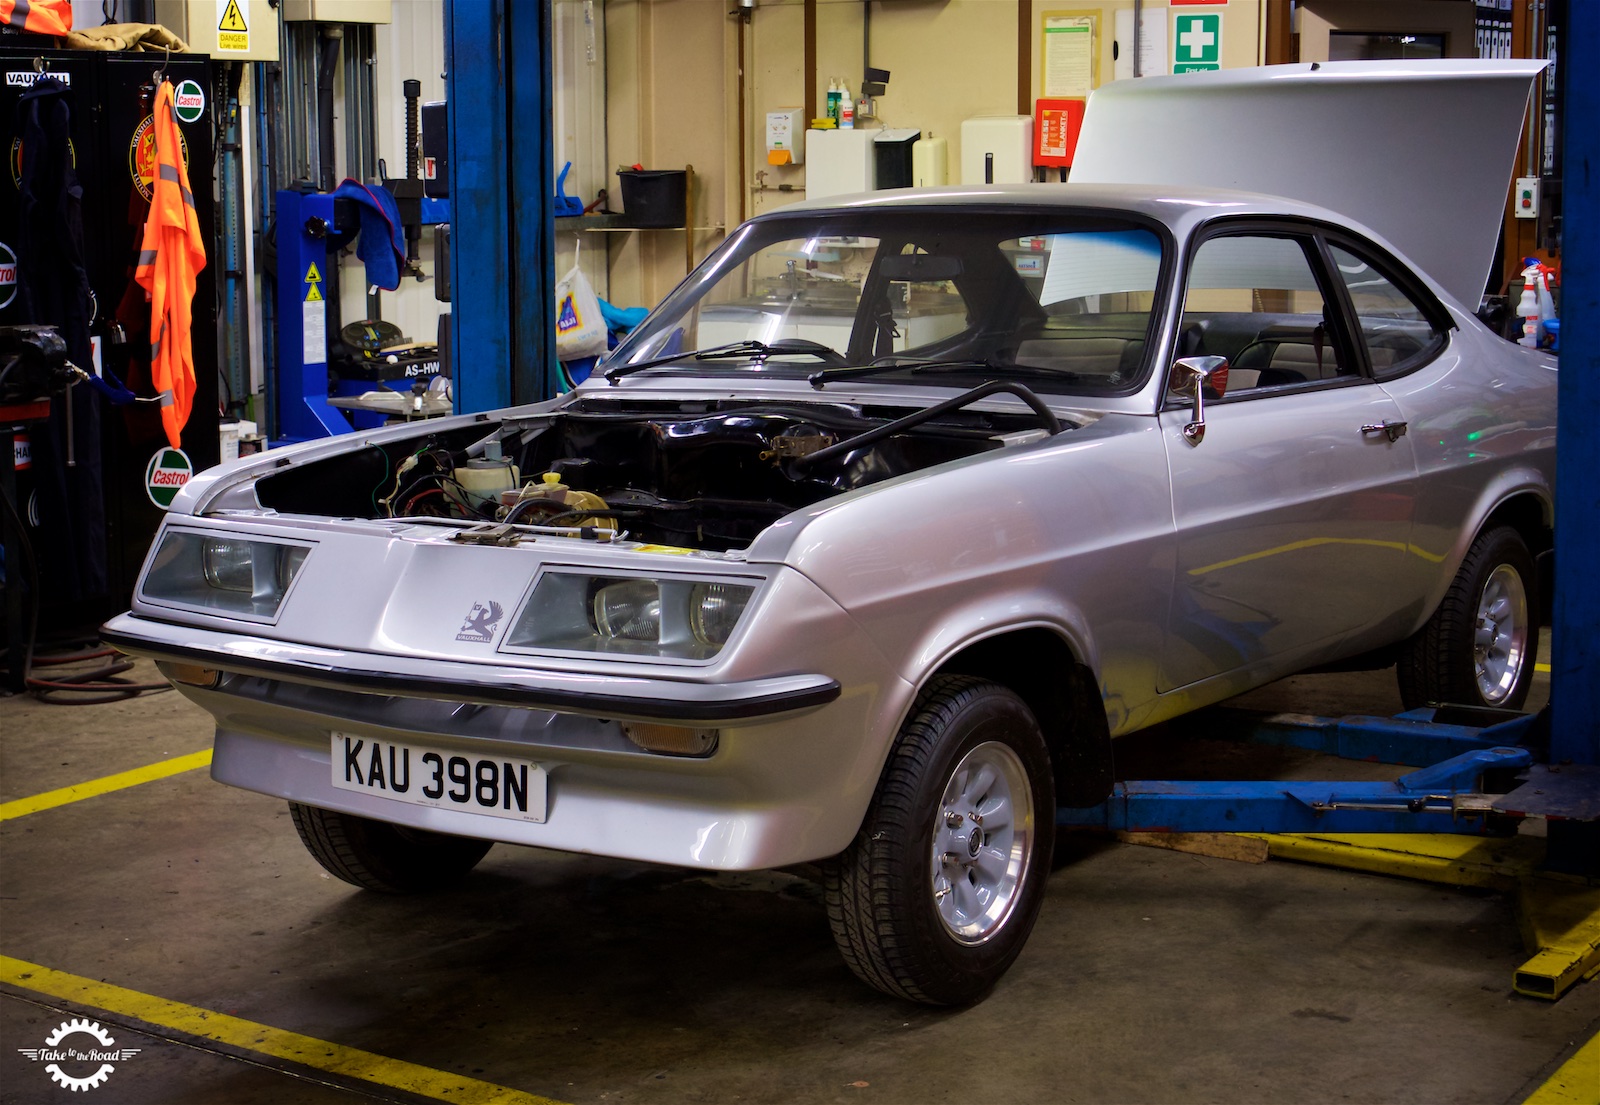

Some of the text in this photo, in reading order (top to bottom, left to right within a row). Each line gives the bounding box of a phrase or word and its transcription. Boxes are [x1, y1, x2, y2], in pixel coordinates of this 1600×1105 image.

[220, 34, 246, 42] DANGER
[178, 95, 202, 107] Castrol
[1041, 131, 1049, 147] FIRE
[1059, 116, 1067, 148] BLANKET
[153, 470, 190, 485] Castrol
[457, 634, 491, 642] VAUXHALL
[345, 737, 528, 812] KAU 398N
